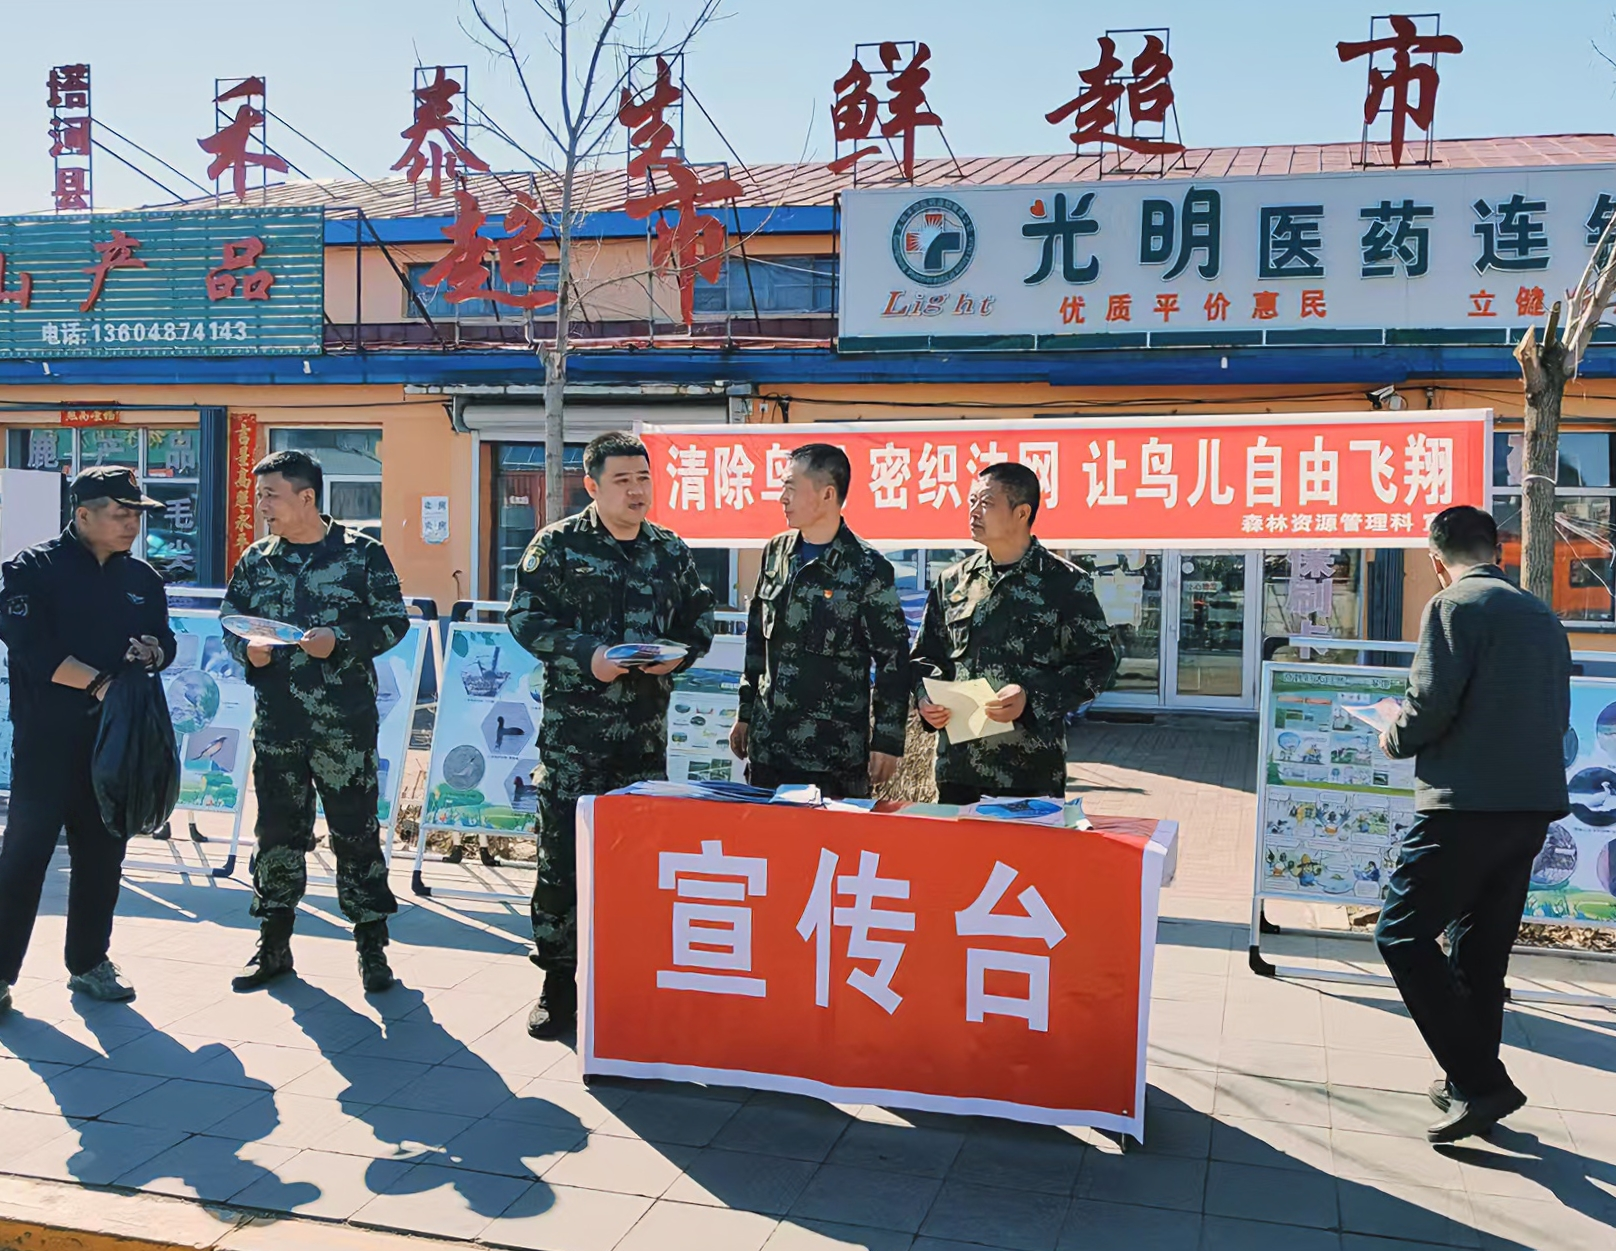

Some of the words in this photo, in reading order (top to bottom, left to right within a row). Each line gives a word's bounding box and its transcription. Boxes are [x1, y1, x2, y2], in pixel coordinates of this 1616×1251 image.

[46, 63, 92, 209] 塔河县
[419, 162, 744, 326] 超市
[881, 290, 997, 318] Light
[1059, 289, 1327, 325] 优质平价惠民
[1082, 432, 1454, 509] 让鸟儿自由飞翔
[1241, 512, 1413, 533] 森林资源管理科
[656, 840, 1067, 1032] 宣传台
